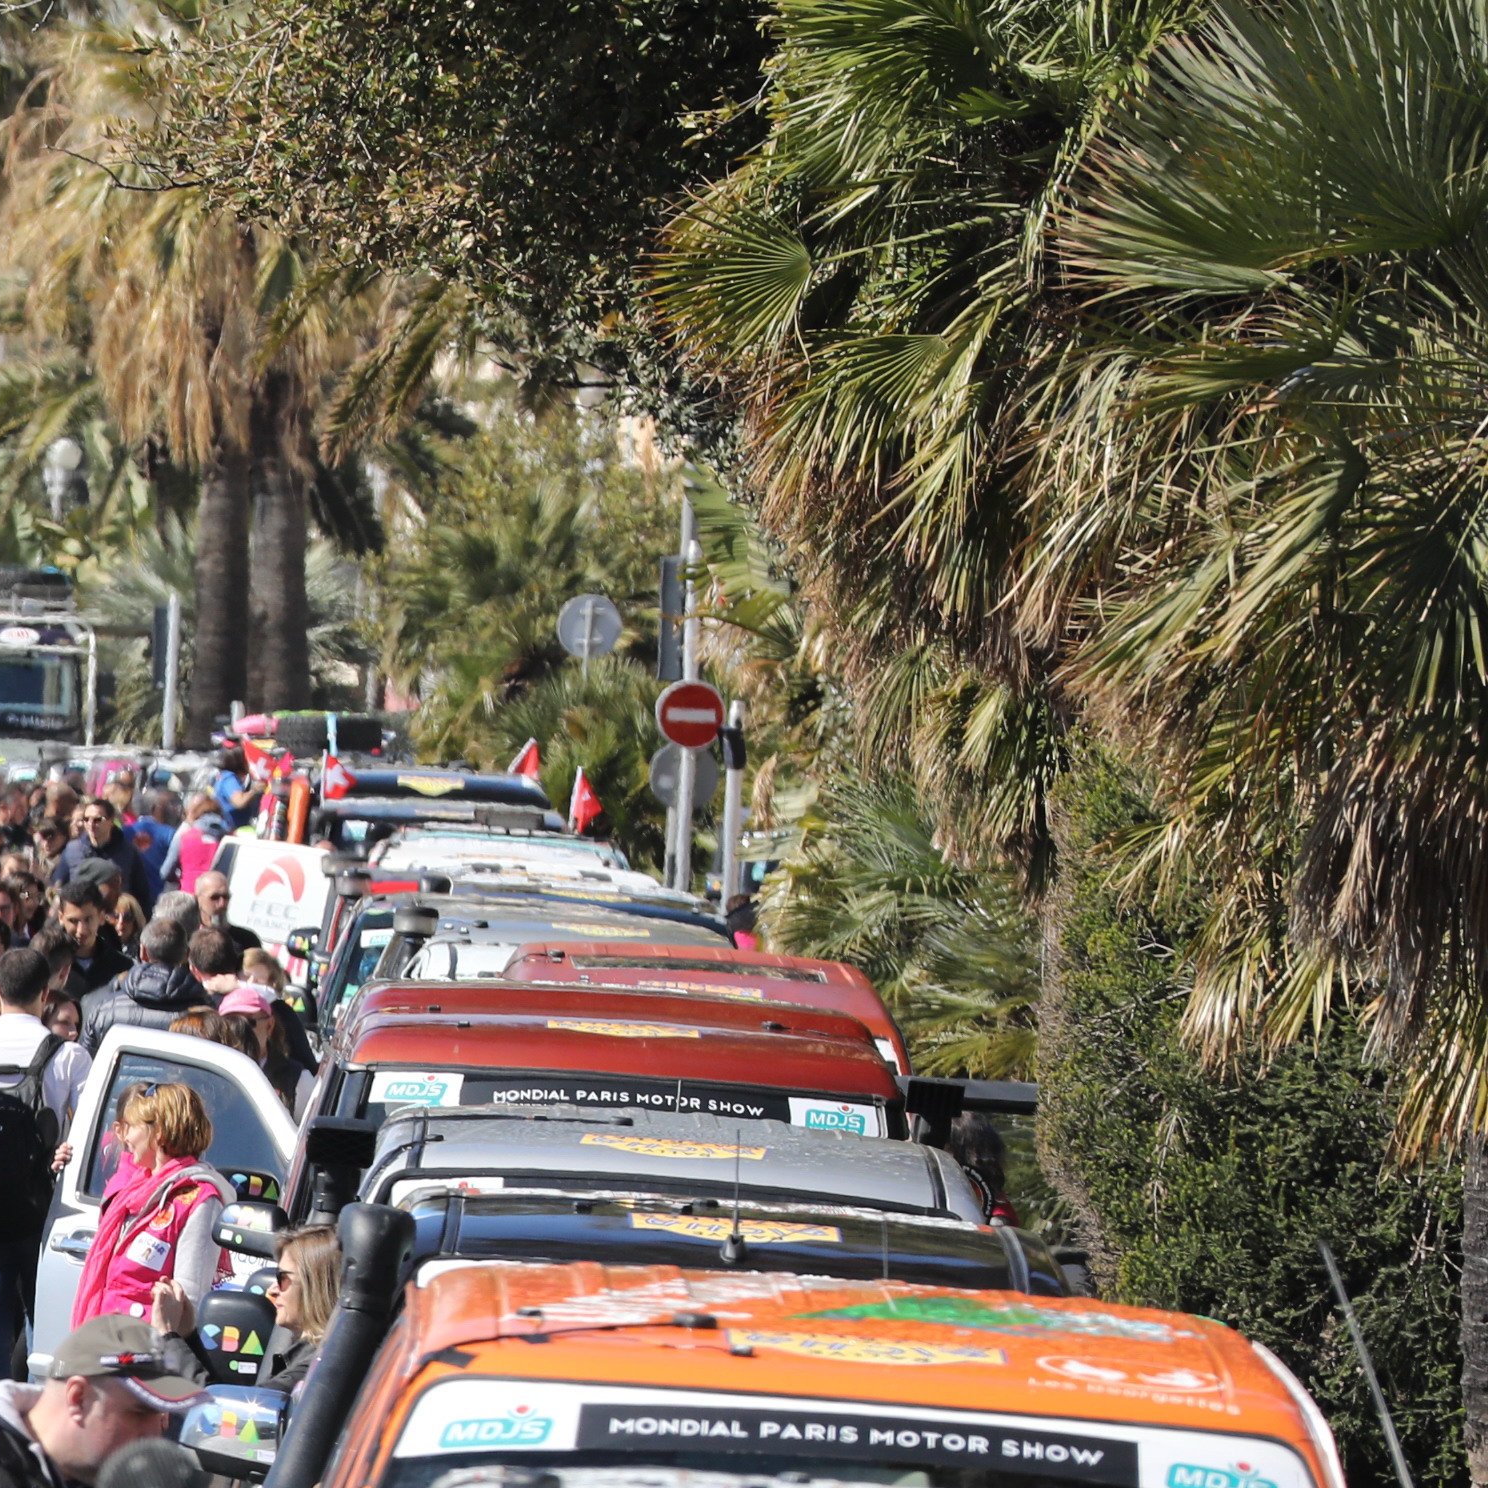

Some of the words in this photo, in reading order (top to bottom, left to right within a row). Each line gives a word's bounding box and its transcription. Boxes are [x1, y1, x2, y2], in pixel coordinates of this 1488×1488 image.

[388, 1082, 444, 1098] MDJS
[493, 1089, 571, 1104] MONDIAL
[575, 1089, 630, 1103] PARIS
[636, 1093, 701, 1110] MOTOR
[708, 1100, 765, 1117] SHOW
[810, 1112, 862, 1129] MDJS
[199, 1323, 265, 1357] CBA
[446, 1420, 547, 1442] MDJS
[608, 1416, 749, 1440] MONDIAL
[758, 1420, 859, 1444] PARIS
[869, 1428, 989, 1454] MOTOR
[1001, 1437, 1104, 1467] SHOW
